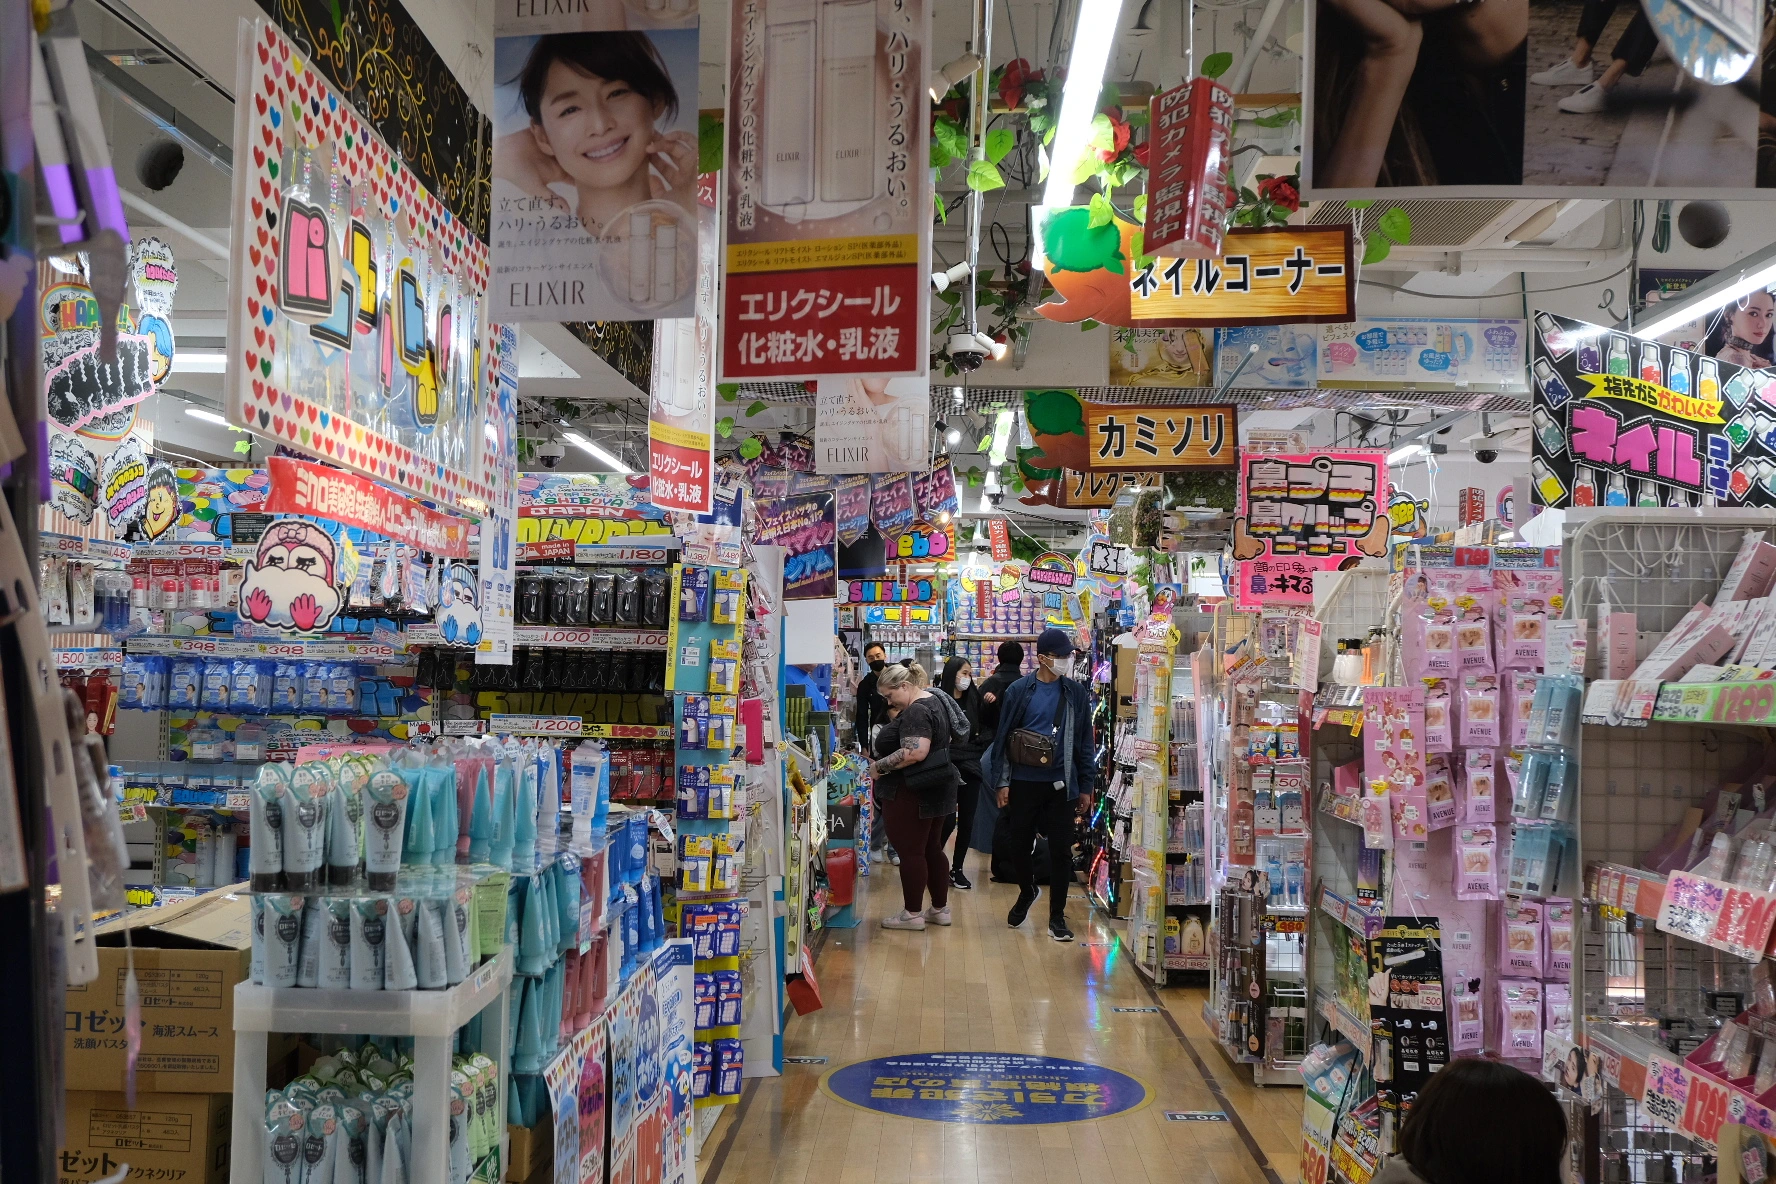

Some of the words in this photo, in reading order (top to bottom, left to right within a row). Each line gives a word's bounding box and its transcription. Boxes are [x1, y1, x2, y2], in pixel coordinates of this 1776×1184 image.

[776, 151, 800, 162] ELIXIR
[835, 149, 860, 160] ELIXIR
[1152, 85, 1193, 240] 防犯カメラ監視中
[499, 194, 563, 213] 立て直す、
[498, 214, 604, 232] ハリ・うるおい。
[1131, 247, 1344, 299] ネイルコーナー
[510, 279, 585, 308] ELIXIR
[738, 284, 901, 322] エリクシール
[738, 325, 901, 366] 化粧水・乳液
[820, 394, 857, 406] 立て直す、
[1602, 376, 1717, 420] 指先からかわいく
[820, 405, 878, 417] ハリ・うるおい。
[1098, 413, 1224, 458] カミソリ
[1571, 405, 1701, 487] ネイル
[827, 446, 869, 463] ELIXIR
[652, 451, 702, 480] エリクシール
[652, 475, 702, 505] 化粧水・乳液
[872, 482, 908, 504] フェイス
[530, 506, 625, 517] JAPAN
[58, 539, 83, 553] 898
[178, 545, 222, 556] 598
[886, 530, 950, 559] nebo
[542, 547, 571, 557] JAPAN
[619, 548, 666, 560] 1,180
[543, 631, 591, 643] 1,000
[182, 641, 217, 652] 398
[267, 644, 305, 655] 398
[356, 644, 393, 656] 398
[1515, 649, 1538, 657] AVENUE
[1428, 660, 1450, 668] AVENUE
[1463, 656, 1485, 664] AVENUE
[1713, 683, 1774, 723] 1200
[430, 720, 440, 728] IN
[533, 718, 581, 732] 1,200
[611, 725, 658, 737] 1200
[1469, 727, 1492, 736] AVENUE
[1425, 734, 1442, 743] VENUE
[1433, 807, 1455, 820] AVENUE
[1474, 803, 1491, 812] AVENUE
[1408, 862, 1428, 870] AVENUE
[1467, 882, 1490, 891] AVENUE
[1278, 921, 1303, 931] 980
[1452, 943, 1472, 951] AVENUE
[1370, 940, 1384, 973] 5
[1510, 958, 1533, 967] AVENUE
[143, 996, 177, 1006] ロゼット
[152, 1024, 219, 1039] 海泥スムース
[1461, 1032, 1479, 1040] AVENUE
[73, 1037, 128, 1050] 洗顔パスタ
[1512, 1038, 1534, 1048] AVENUE
[871, 1087, 1108, 1106] 万引き犯罪
[115, 1138, 148, 1149] ロゼット
[59, 1150, 118, 1176] ゼット
[126, 1167, 187, 1181] アクネクリア
